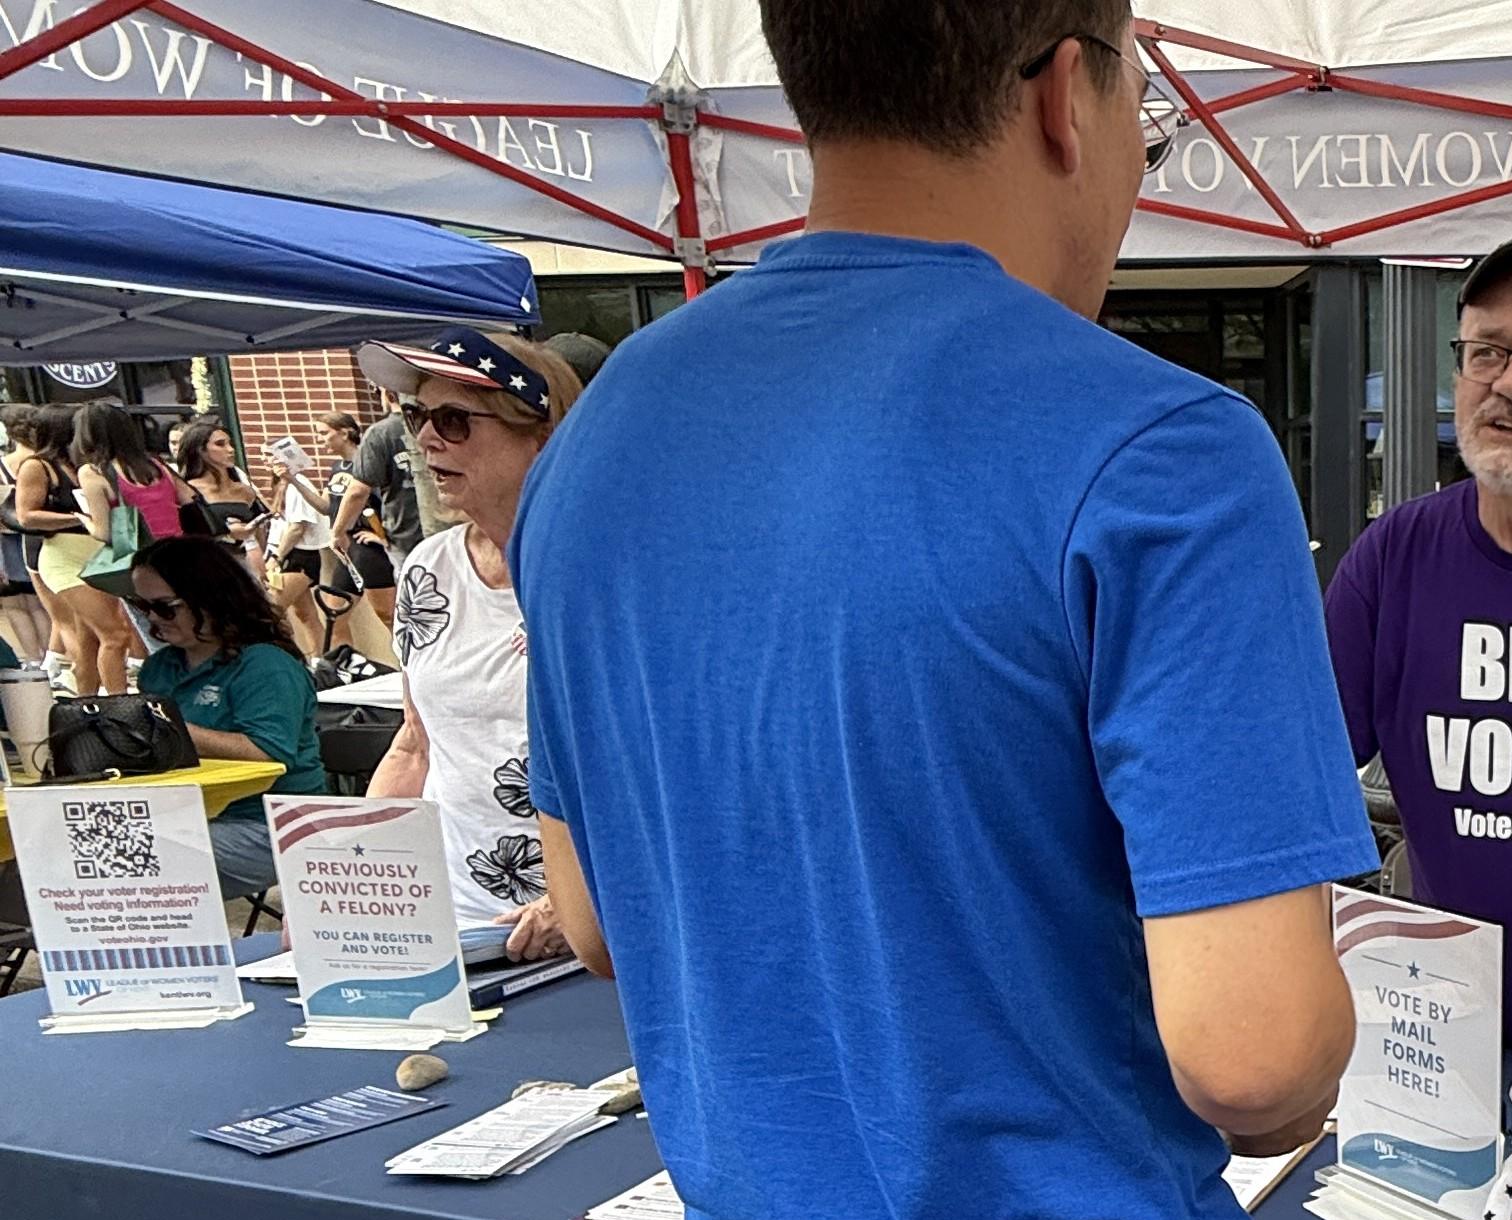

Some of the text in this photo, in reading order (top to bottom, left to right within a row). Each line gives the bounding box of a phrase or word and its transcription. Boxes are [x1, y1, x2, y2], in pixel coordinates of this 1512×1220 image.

[305, 861, 418, 879] PREVIOUSLY
[39, 883, 209, 902] Check your voter registration!
[299, 880, 432, 899] CONVICTED OF
[54, 897, 199, 912] Need voting information?
[320, 900, 417, 917] A FELONY?
[313, 930, 433, 945] YOU CAN REGISTER
[341, 944, 408, 956] AND VOTE!
[64, 978, 100, 997] LWV
[1375, 985, 1451, 1024] VOTE BY
[1391, 1015, 1437, 1047] MAIL
[1383, 1038, 1446, 1075] FORMS
[1387, 1065, 1440, 1098] HERE!
